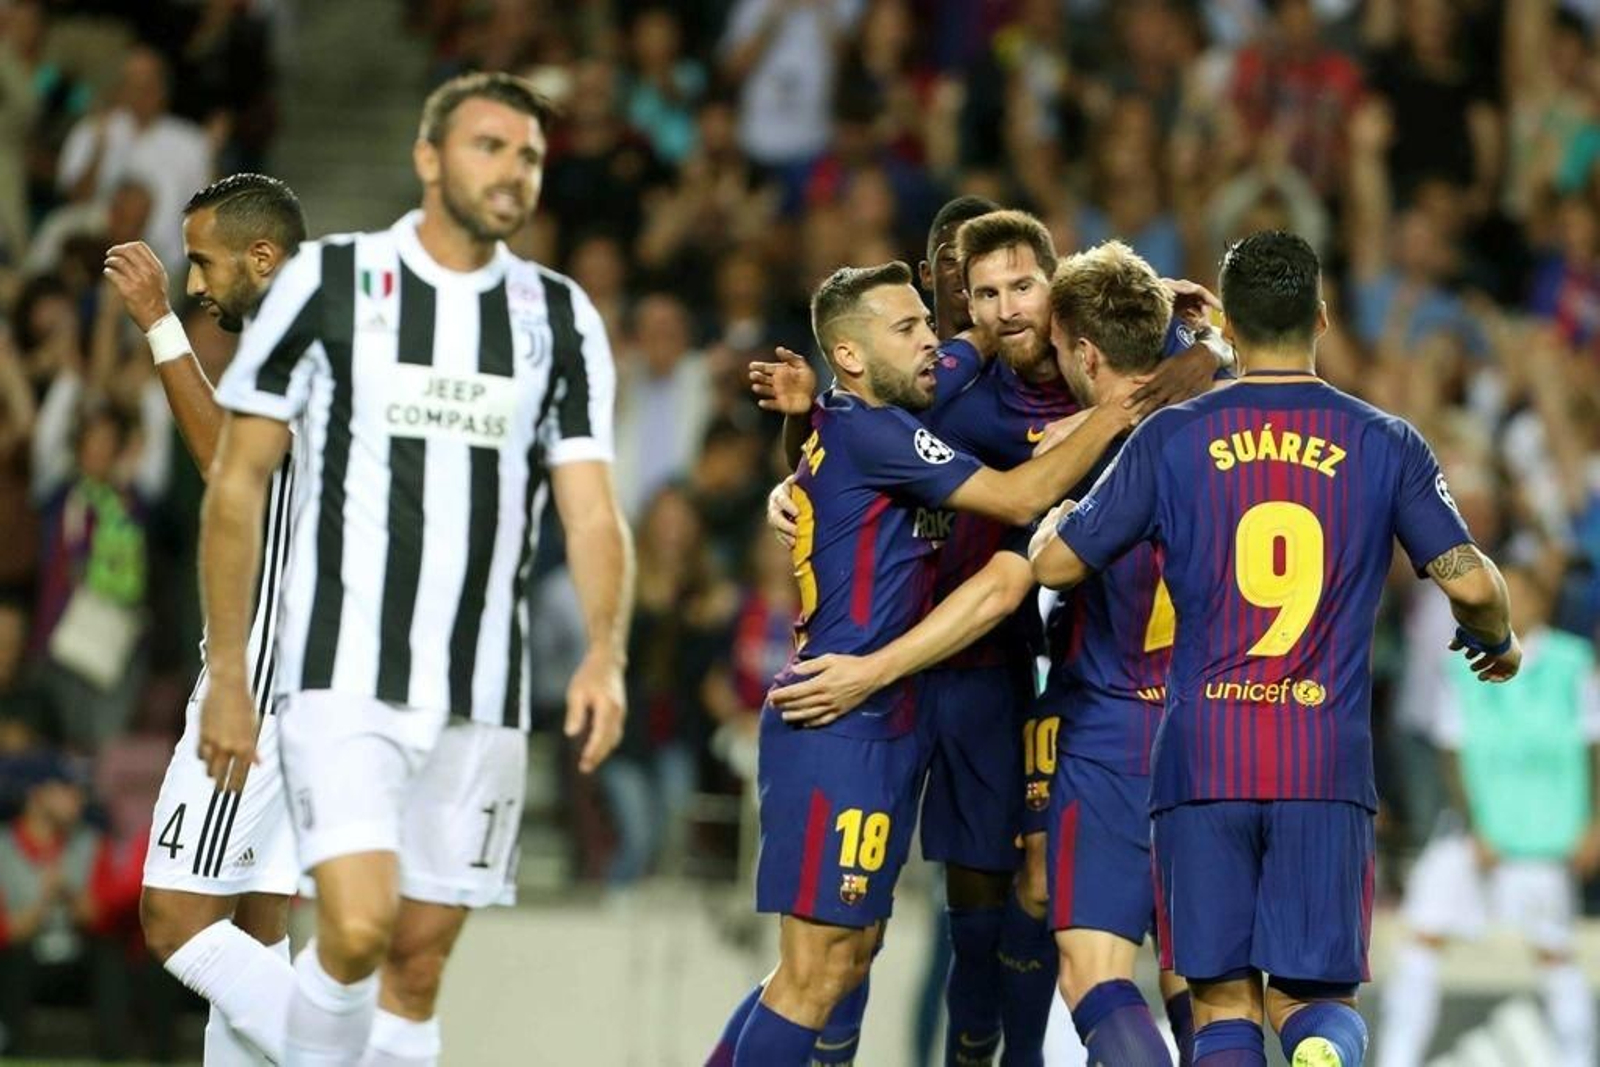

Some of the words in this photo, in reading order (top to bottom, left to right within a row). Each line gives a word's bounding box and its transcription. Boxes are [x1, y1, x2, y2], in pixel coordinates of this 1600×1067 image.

[424, 378, 487, 400] JEEP
[386, 403, 508, 437] COMPASS
[1209, 423, 1347, 477] SUÁREZ
[1235, 501, 1324, 656] 9
[1205, 678, 1291, 703] unicef
[1023, 716, 1060, 775] 10
[158, 803, 187, 859] 4
[835, 808, 890, 871] 18
